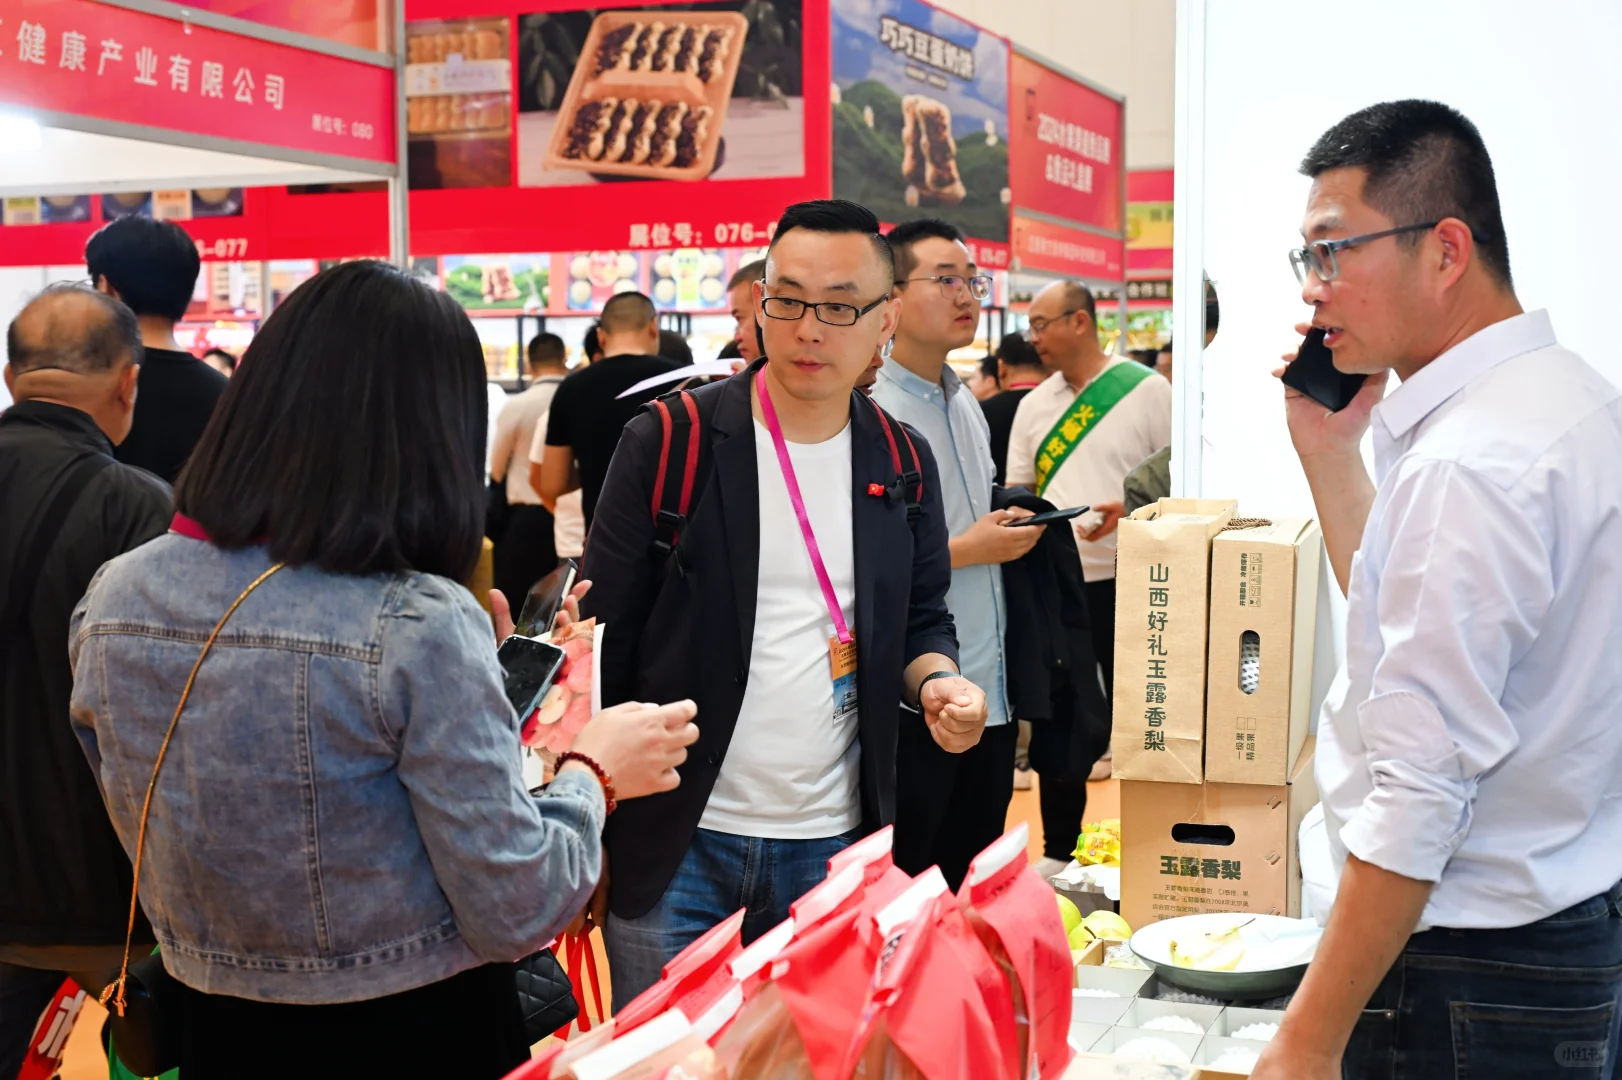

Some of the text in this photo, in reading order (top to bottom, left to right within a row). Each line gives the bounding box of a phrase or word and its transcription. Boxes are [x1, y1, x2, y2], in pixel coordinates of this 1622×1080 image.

[0, 19, 285, 110] 健康产业有限公司
[1144, 563, 1170, 752] 山西好礼玉露香梨
[1235, 732, 1245, 760] 一级果
[1246, 733, 1256, 761] 精品果
[1159, 855, 1242, 881] 玉露香梨
